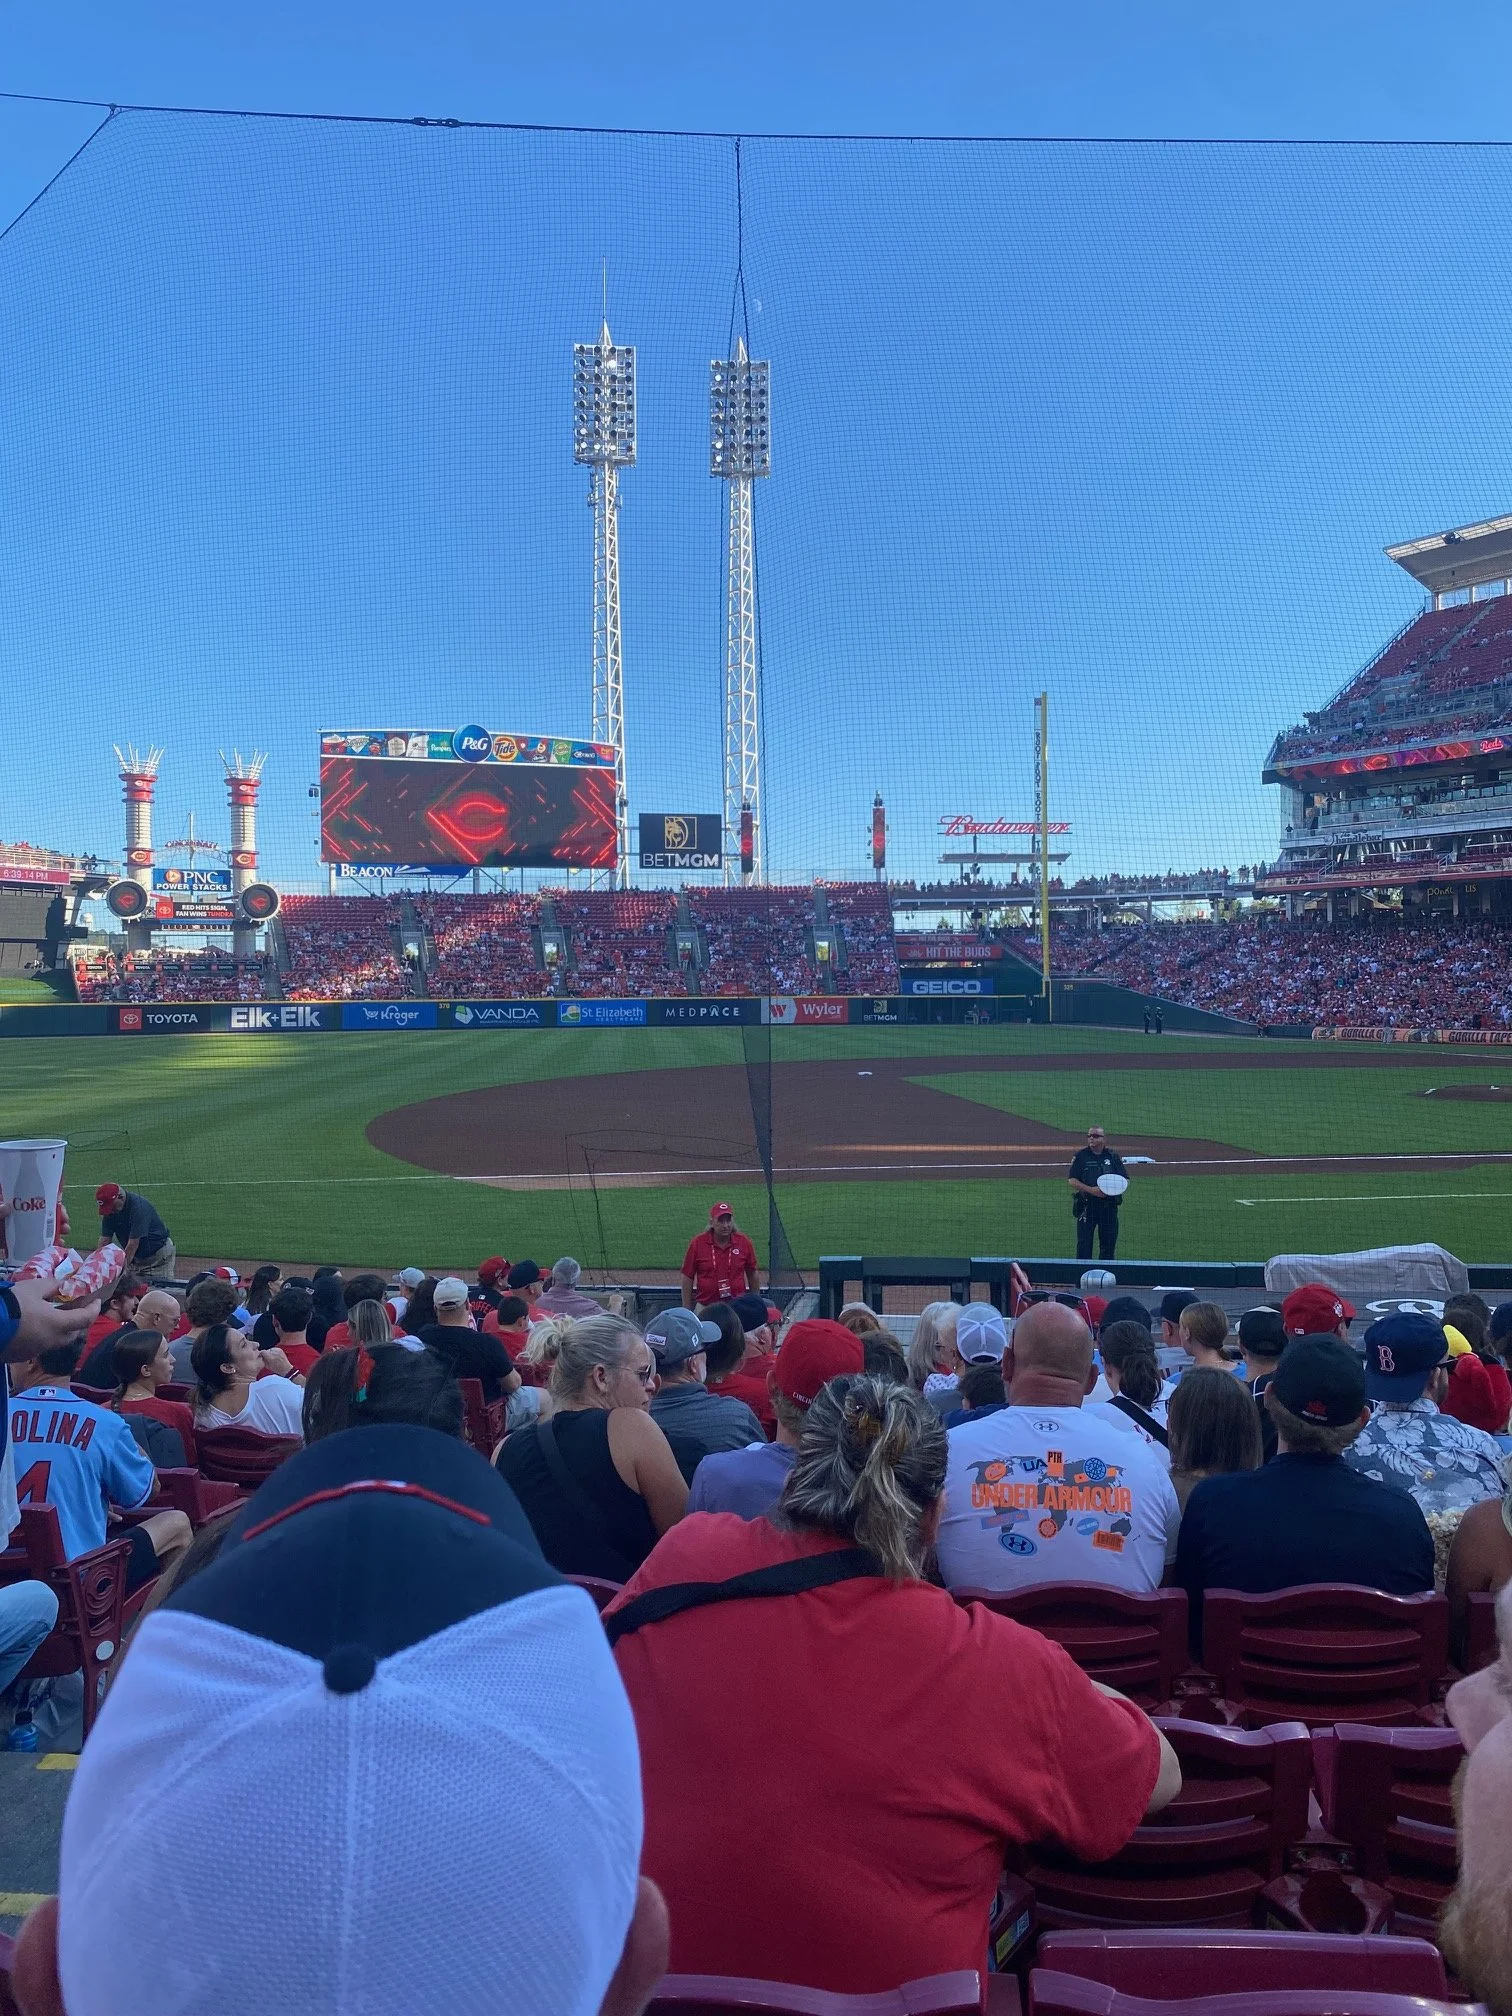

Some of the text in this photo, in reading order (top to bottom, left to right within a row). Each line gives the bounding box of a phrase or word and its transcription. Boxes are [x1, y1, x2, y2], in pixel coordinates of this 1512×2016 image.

[462, 737, 489, 750] P&G
[494, 741, 516, 755] Tide
[1480, 737, 1503, 753] Reds
[642, 853, 719, 868] BETMGM
[3, 869, 49, 881] 6:39:14 PM
[182, 871, 219, 884] PNC
[340, 863, 393, 878] BEACON
[192, 883, 228, 891] STACKS
[208, 910, 234, 918] TUNDRA
[925, 946, 991, 958] HIT THE BUDS
[912, 980, 981, 994] GEICO
[381, 1005, 420, 1026] Kroger
[474, 1008, 540, 1019] VANDA
[595, 1007, 643, 1018] Elizabeth
[665, 1004, 741, 1017] MEDPACE
[801, 1002, 843, 1019] Wyler
[146, 1012, 198, 1024] TOYOTA
[1341, 1027, 1398, 1041] GORILLA GE
[1449, 1031, 1487, 1043] GORILLA
[12, 1197, 46, 1212] Coke
[1377, 1344, 1395, 1372] B
[11, 1409, 97, 1452] OLINA
[1022, 1458, 1048, 1472] UA
[971, 1482, 1133, 1513] UNDER ARMOUR
